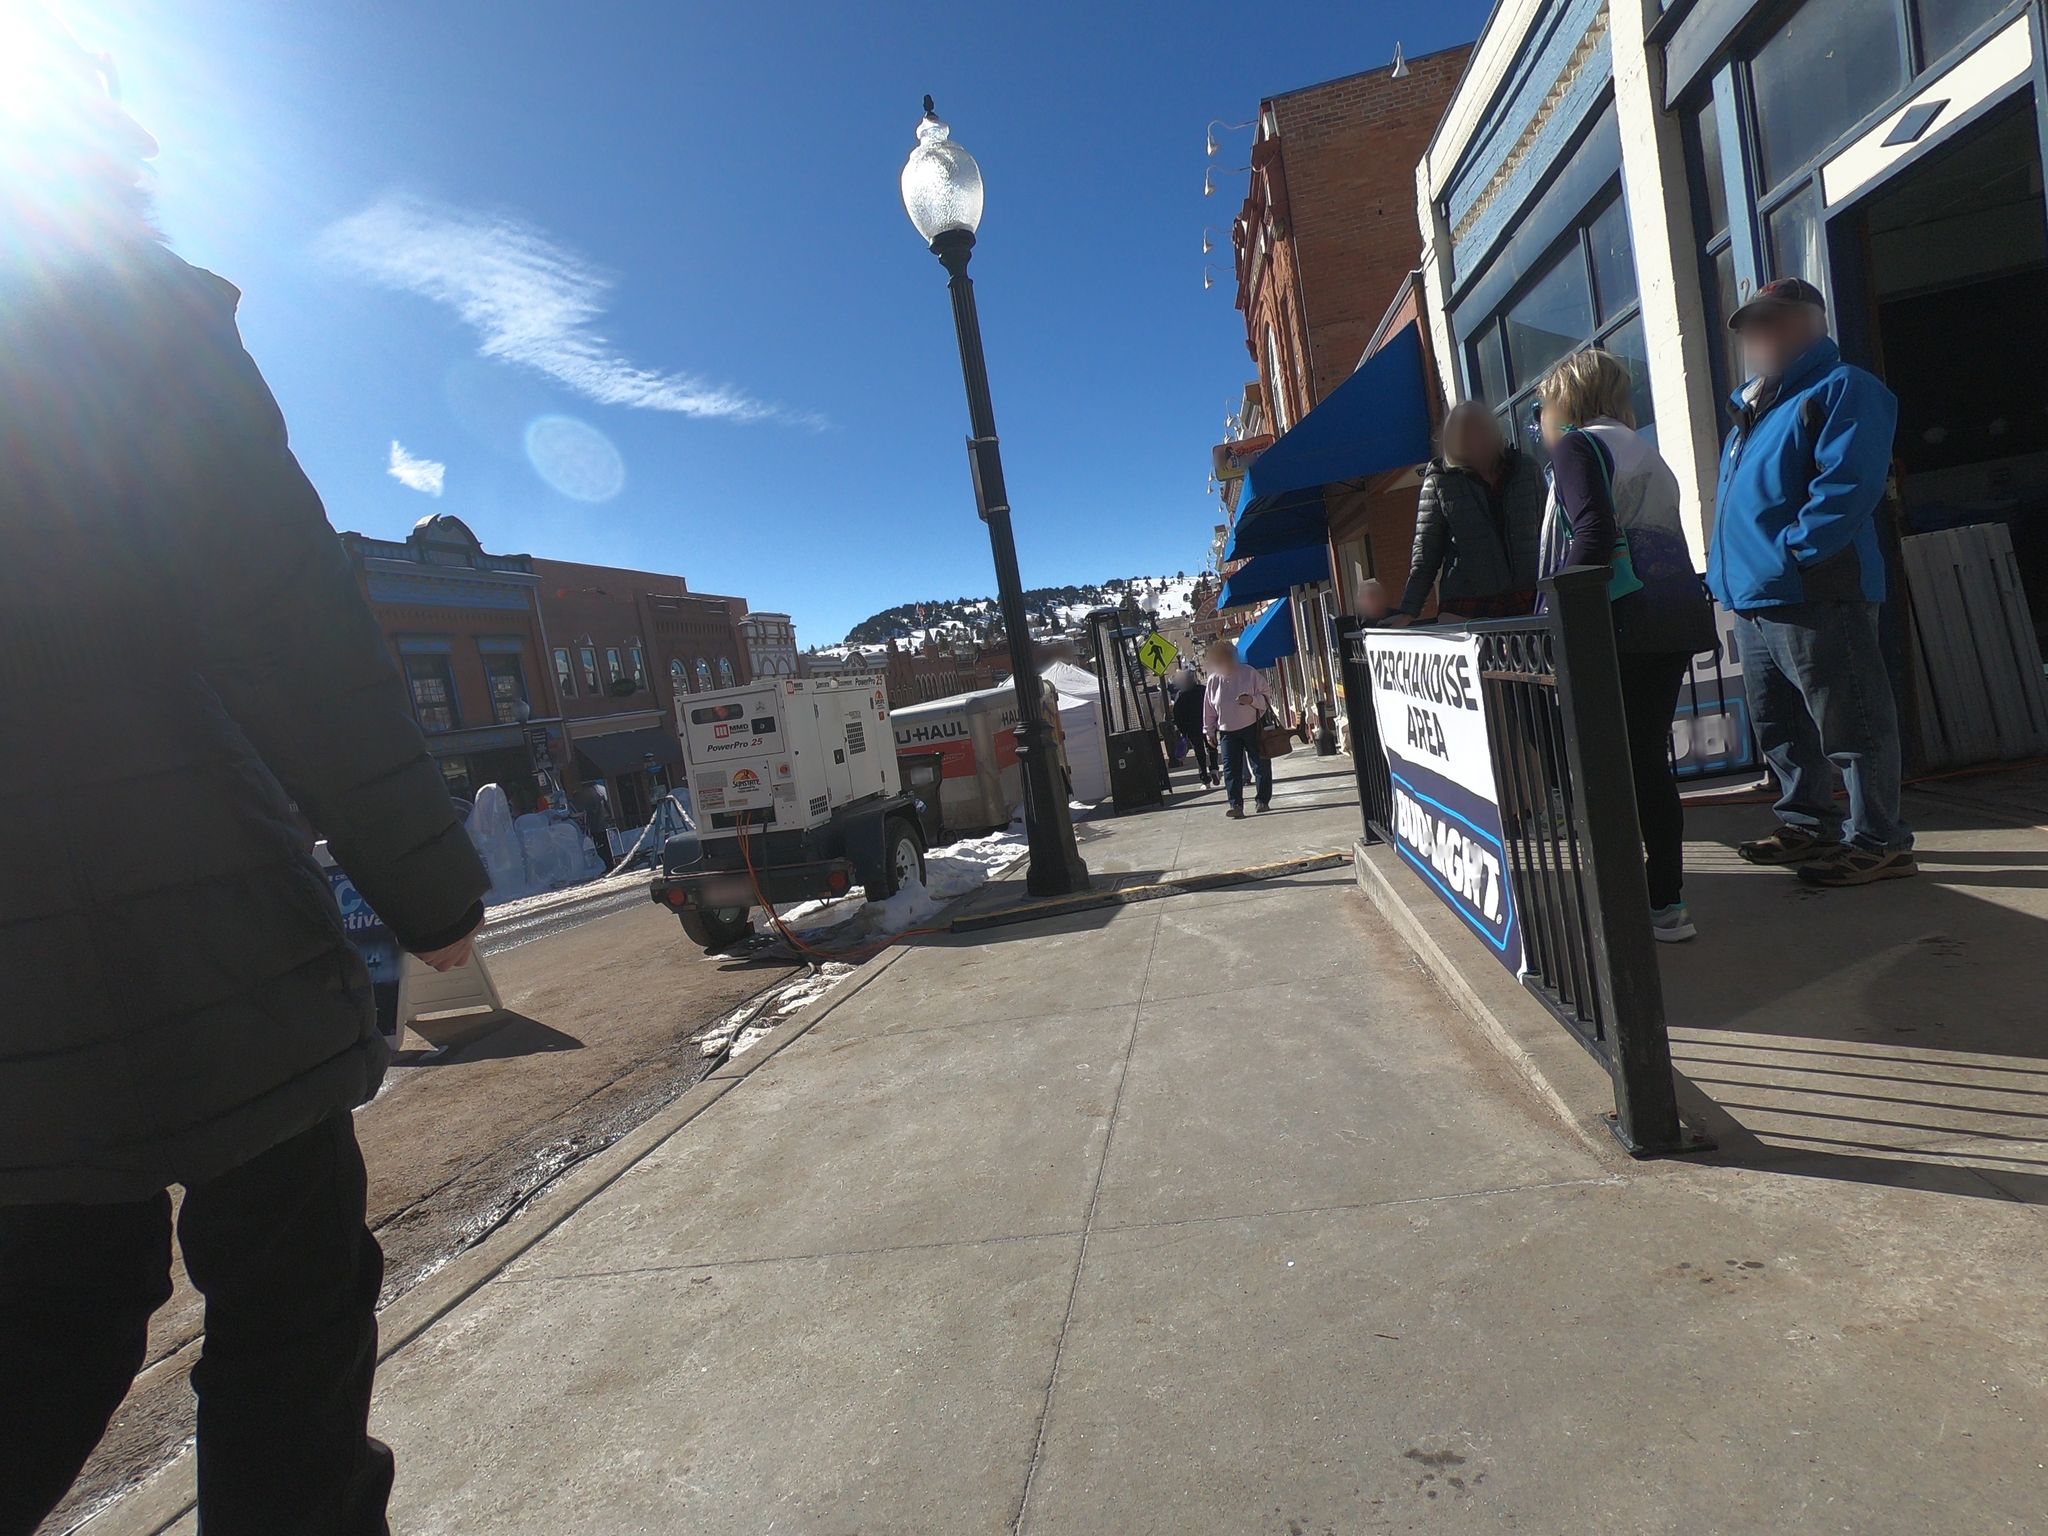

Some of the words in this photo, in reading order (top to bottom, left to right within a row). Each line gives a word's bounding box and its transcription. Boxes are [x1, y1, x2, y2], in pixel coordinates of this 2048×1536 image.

[1369, 650, 1479, 711] MERCHANDISE
[729, 723, 749, 731] MMD
[896, 721, 969, 745] U-HAUL
[1407, 704, 1449, 762] AREA
[706, 741, 749, 753] PowerPro
[751, 737, 764, 747] 25
